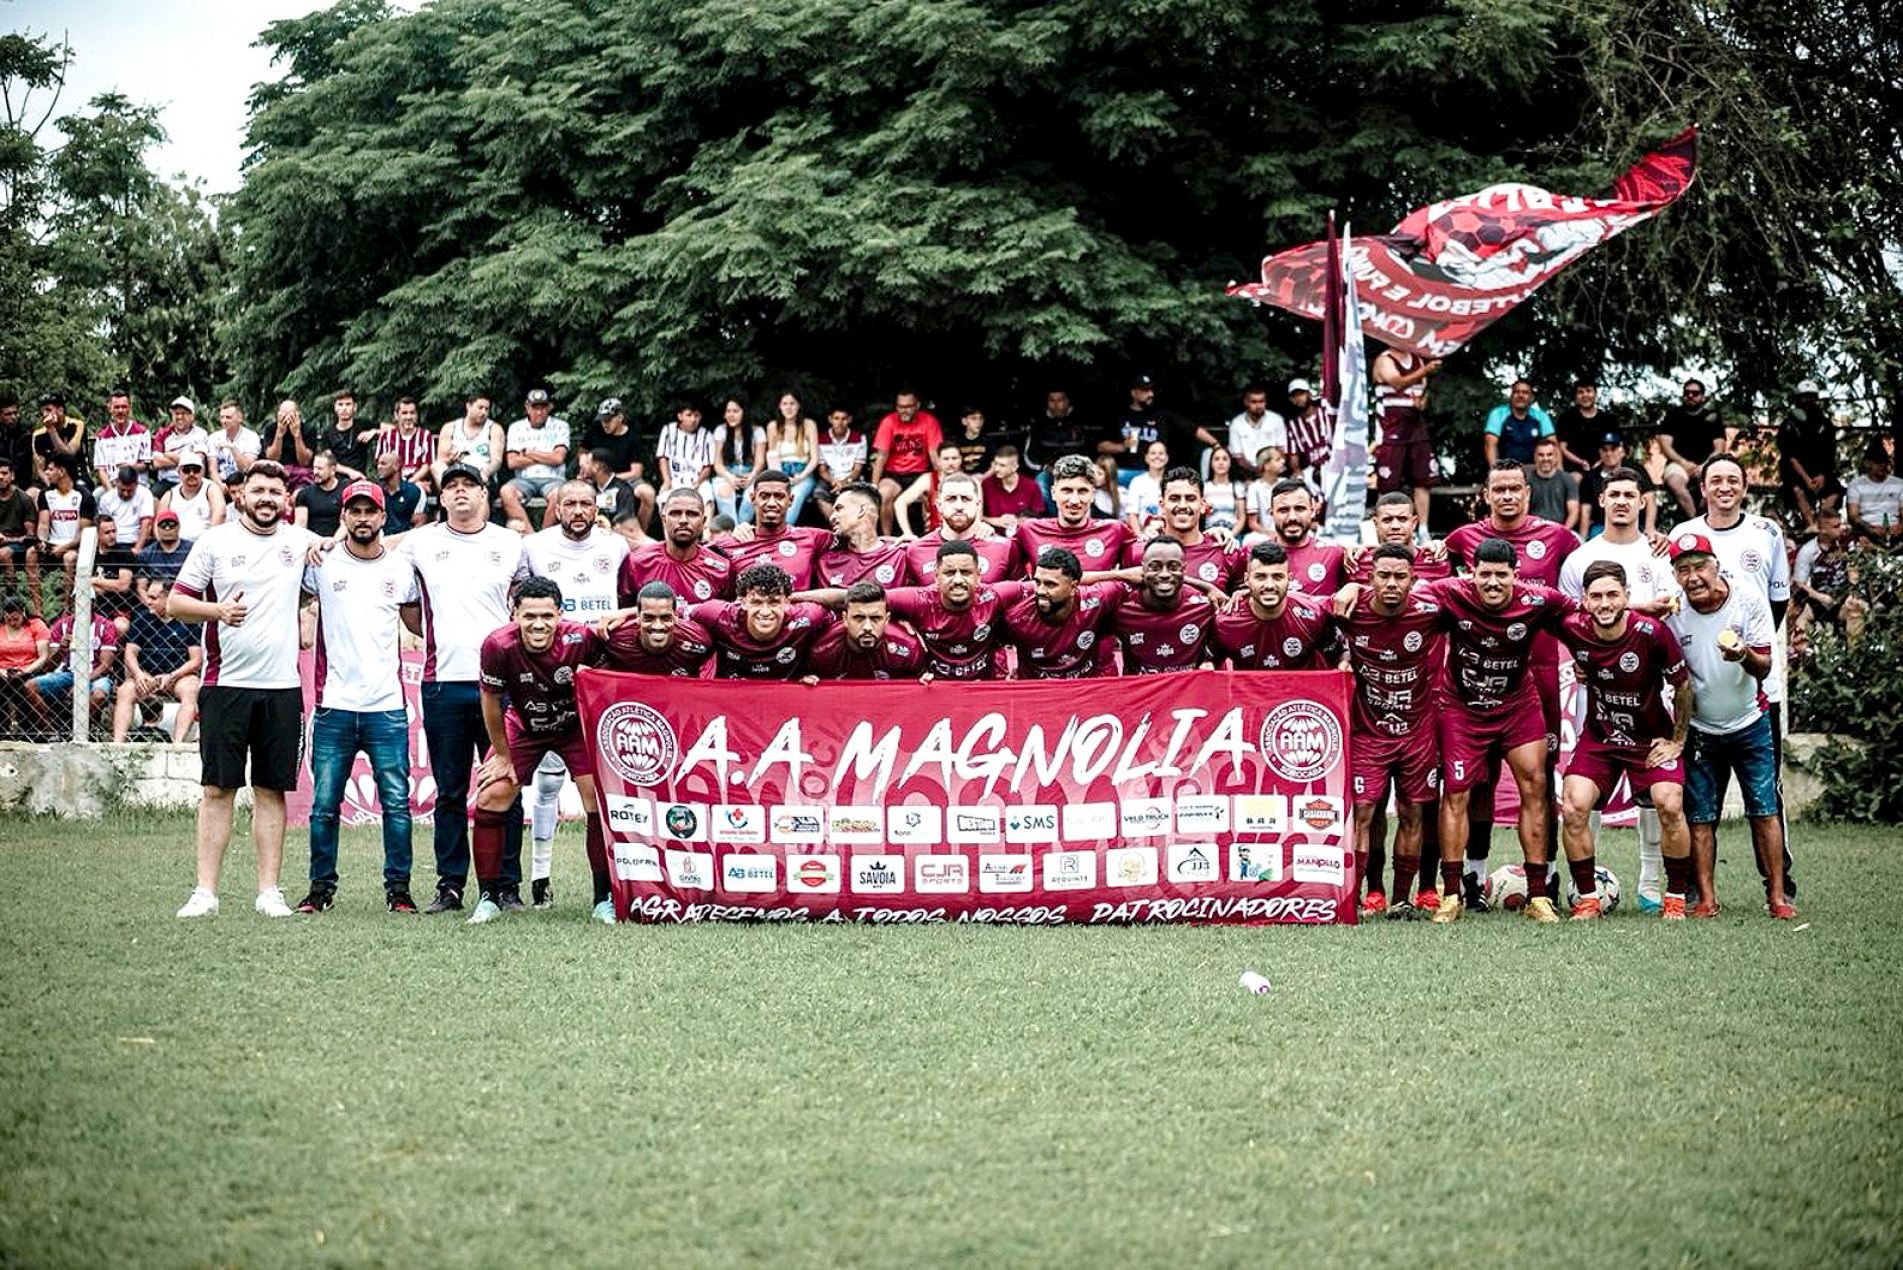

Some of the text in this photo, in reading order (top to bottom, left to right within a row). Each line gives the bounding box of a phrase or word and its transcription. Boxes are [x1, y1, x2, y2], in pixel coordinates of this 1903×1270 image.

[581, 600, 611, 611] BETEL
[1483, 659, 1519, 670] BETEL
[1385, 670, 1418, 684] BETEL
[1605, 694, 1641, 707] BETEL
[616, 733, 660, 756] AAM
[1280, 731, 1325, 751] AAM
[832, 707, 1256, 803] MAGNOLIA
[1454, 760, 1464, 780] 5
[1354, 776, 1364, 794] 6
[1023, 815, 1055, 830] SMS
[1123, 813, 1169, 822] VELO TRUCK
[921, 863, 964, 877] CJR
[859, 871, 897, 885] SAVOIA
[852, 907, 946, 922] TODOS
[1090, 896, 1338, 923] PATROCINADORES
